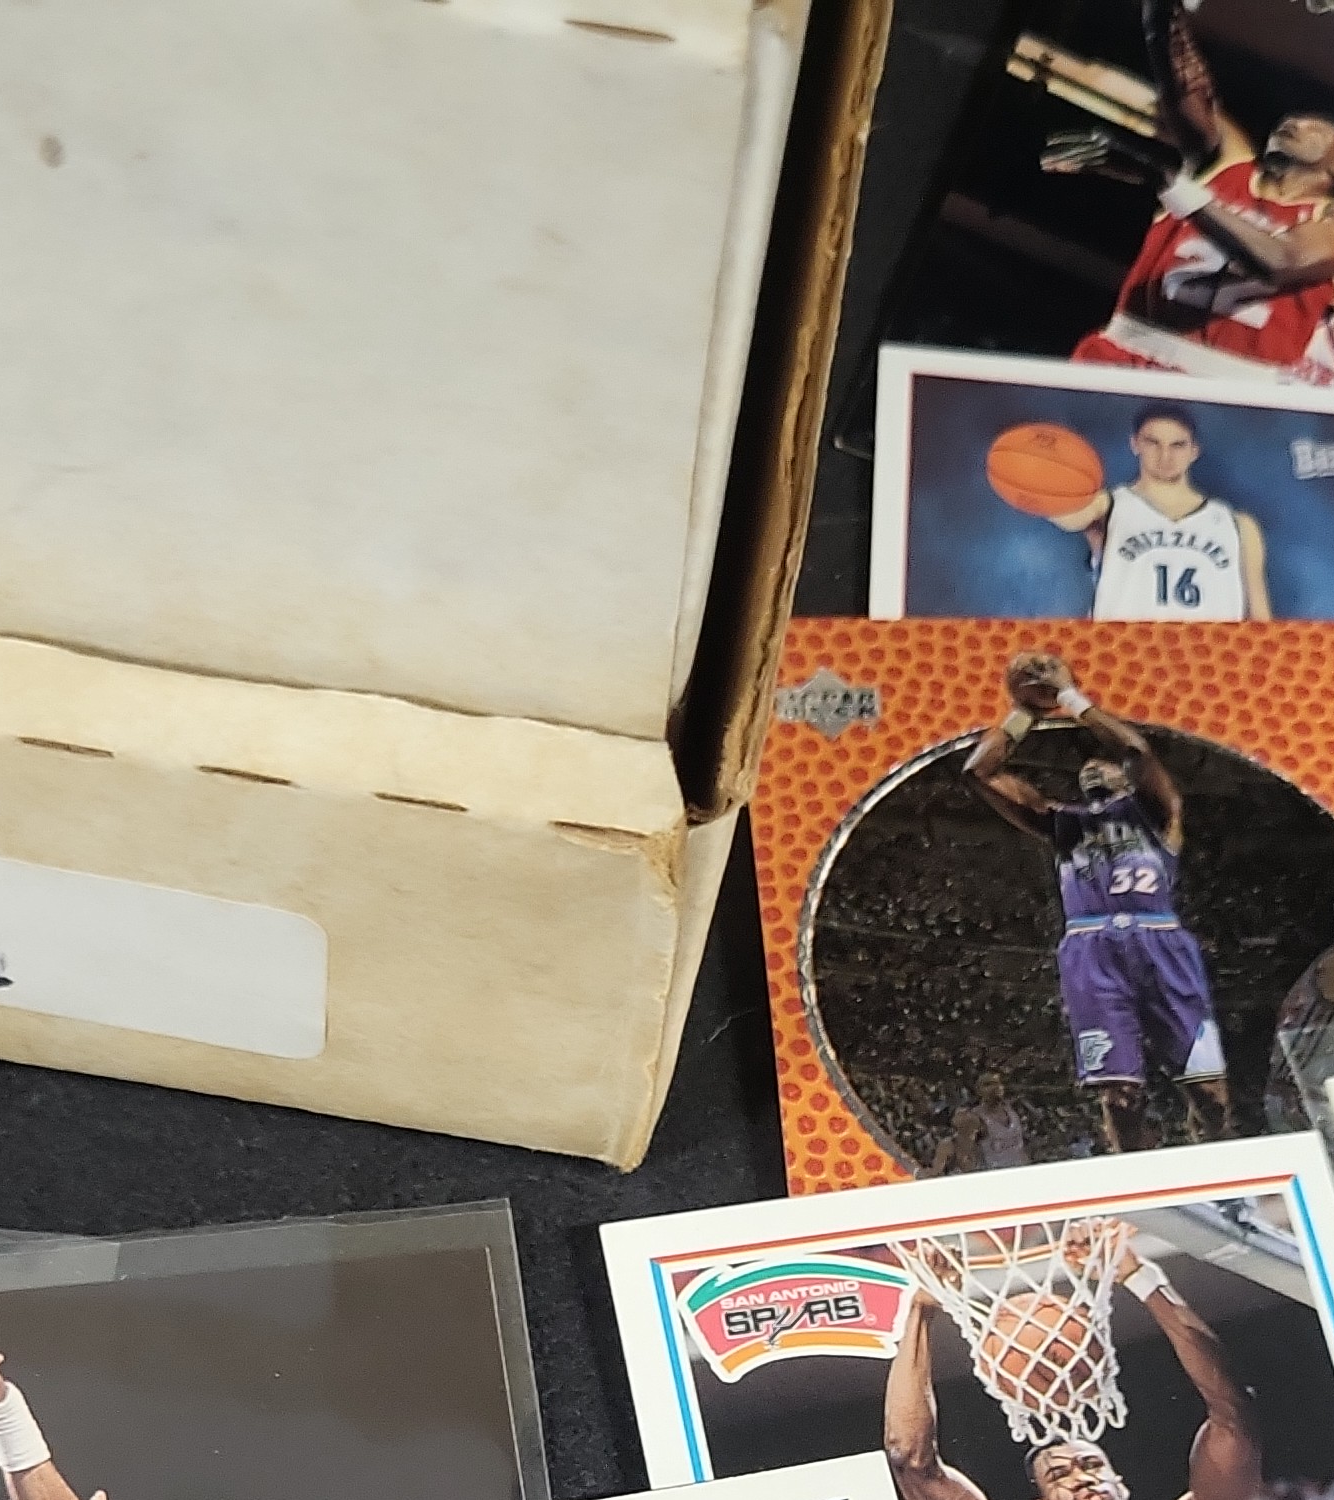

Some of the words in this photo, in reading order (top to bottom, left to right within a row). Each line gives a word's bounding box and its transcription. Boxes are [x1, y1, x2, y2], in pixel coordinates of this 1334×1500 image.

[1117, 530, 1232, 570] GRIZZLIES
[1153, 563, 1203, 608] 16
[1108, 867, 1159, 896] 32
[720, 1292, 765, 1310] SAN
[768, 1281, 860, 1304] ANTONIO
[723, 1295, 865, 1343] SPURS
